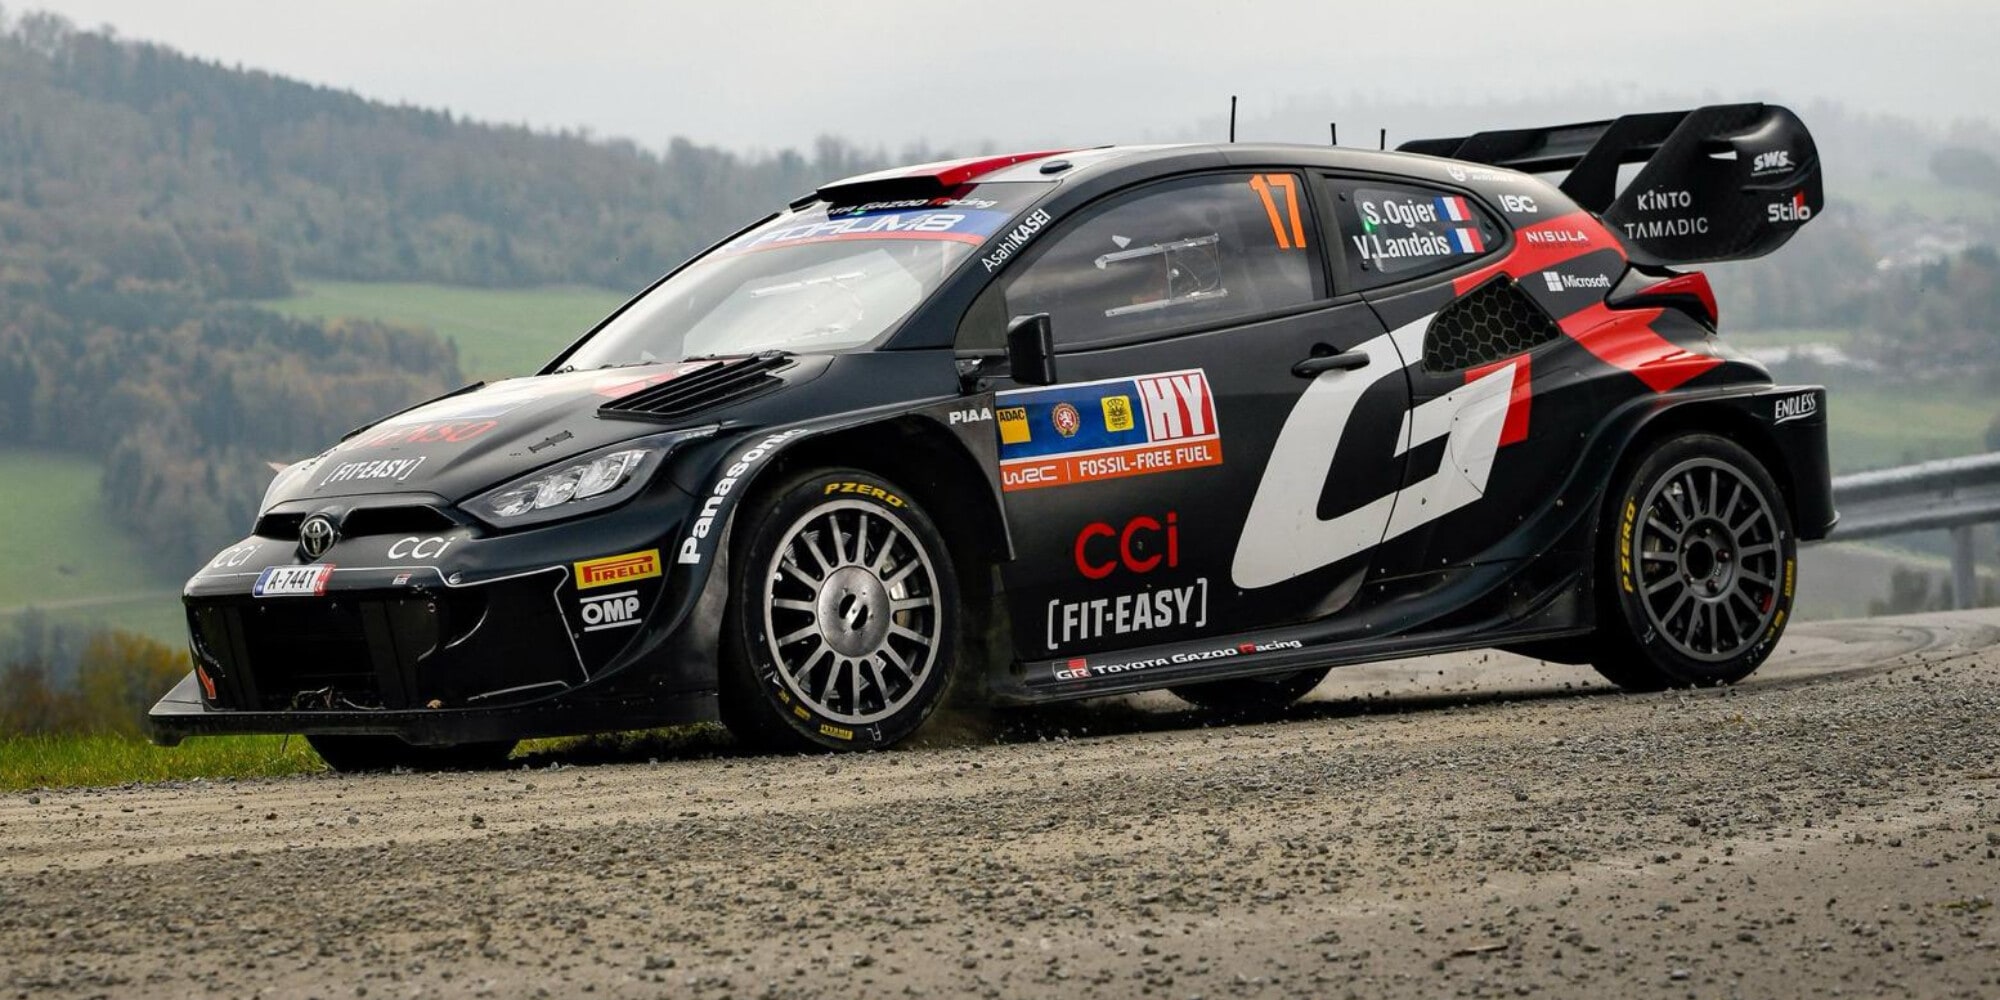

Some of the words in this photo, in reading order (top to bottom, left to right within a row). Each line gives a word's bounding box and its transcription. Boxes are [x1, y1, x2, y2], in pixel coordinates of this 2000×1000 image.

[1753, 150, 1789, 172] SWS
[1249, 173, 1307, 249] 17
[1363, 199, 1437, 229] S.Ogier
[1767, 193, 1811, 223] Stilo
[1525, 230, 1589, 243] NISULA
[1624, 217, 1709, 240] TAMADIC
[1353, 232, 1450, 260] V.Landais
[1561, 274, 1612, 288] Microsoft
[950, 407, 993, 425] PIAA
[999, 409, 1025, 422] ADAC
[1142, 374, 1203, 440] HY
[1775, 391, 1817, 419] ENDLESS
[1003, 465, 1057, 485] WRC
[1079, 450, 1172, 477] FOSSIL-FREE
[1176, 445, 1212, 463] FUEL
[267, 570, 316, 590] A-7441
[583, 555, 654, 583] PIRELLI
[582, 597, 640, 625] OMP
[1056, 668, 1092, 680] GR
[1092, 657, 1168, 675] TOYOTA
[1172, 648, 1238, 663] GAZOO
[1238, 639, 1303, 656] Racing
